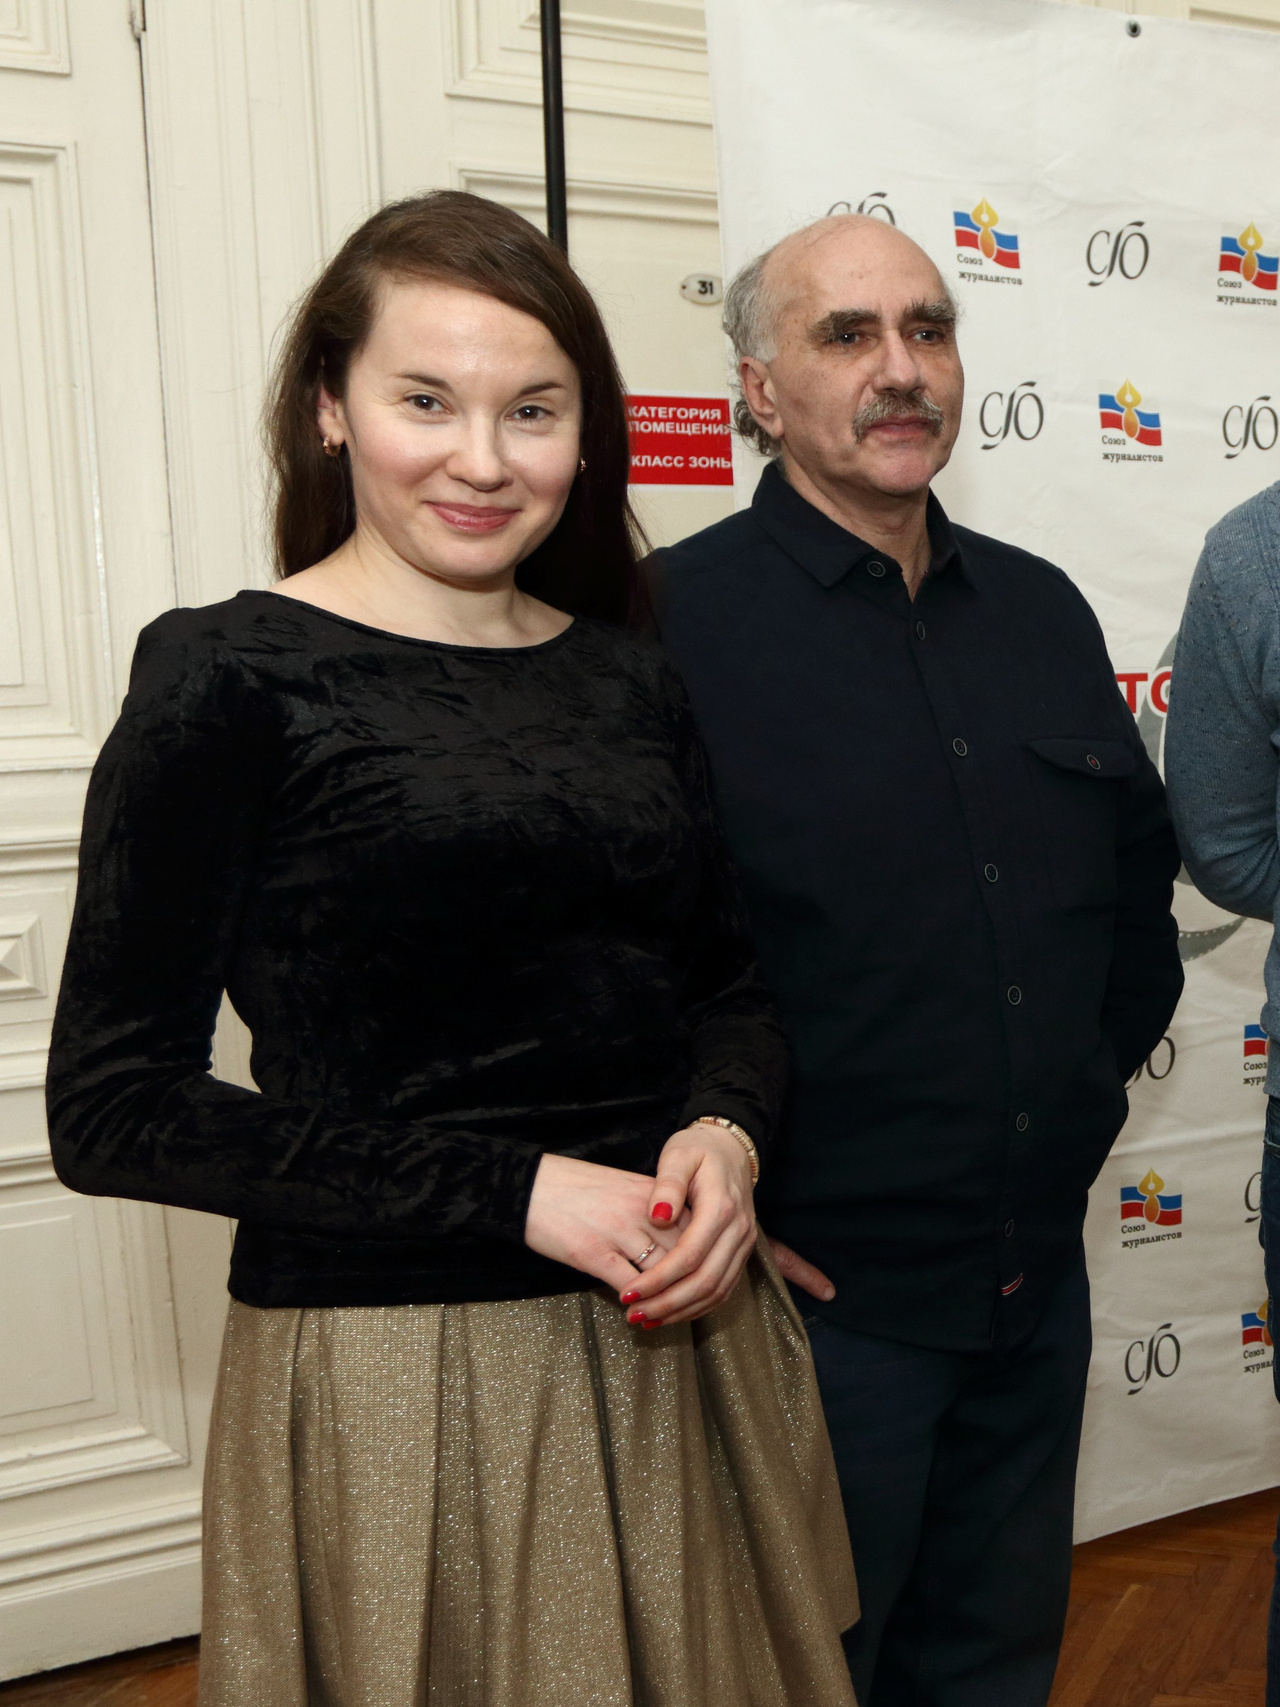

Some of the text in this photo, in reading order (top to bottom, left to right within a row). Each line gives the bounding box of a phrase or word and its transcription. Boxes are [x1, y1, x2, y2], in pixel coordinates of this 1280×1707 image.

[956, 253, 983, 266] Союз
[958, 271, 1023, 286] журналистов
[1217, 277, 1242, 289] Союз
[698, 280, 714, 295] 31
[1216, 294, 1278, 306] журналистов
[628, 405, 722, 421] КАТЕГОРИЯ
[1101, 435, 1126, 446] Союз
[631, 455, 684, 468] КЛАСС
[1102, 452, 1164, 463] журналистов
[1243, 1062, 1267, 1072] Союз
[1121, 1223, 1146, 1234] Союз
[1121, 1231, 1182, 1249] журналистов
[1243, 1348, 1265, 1360] Союз
